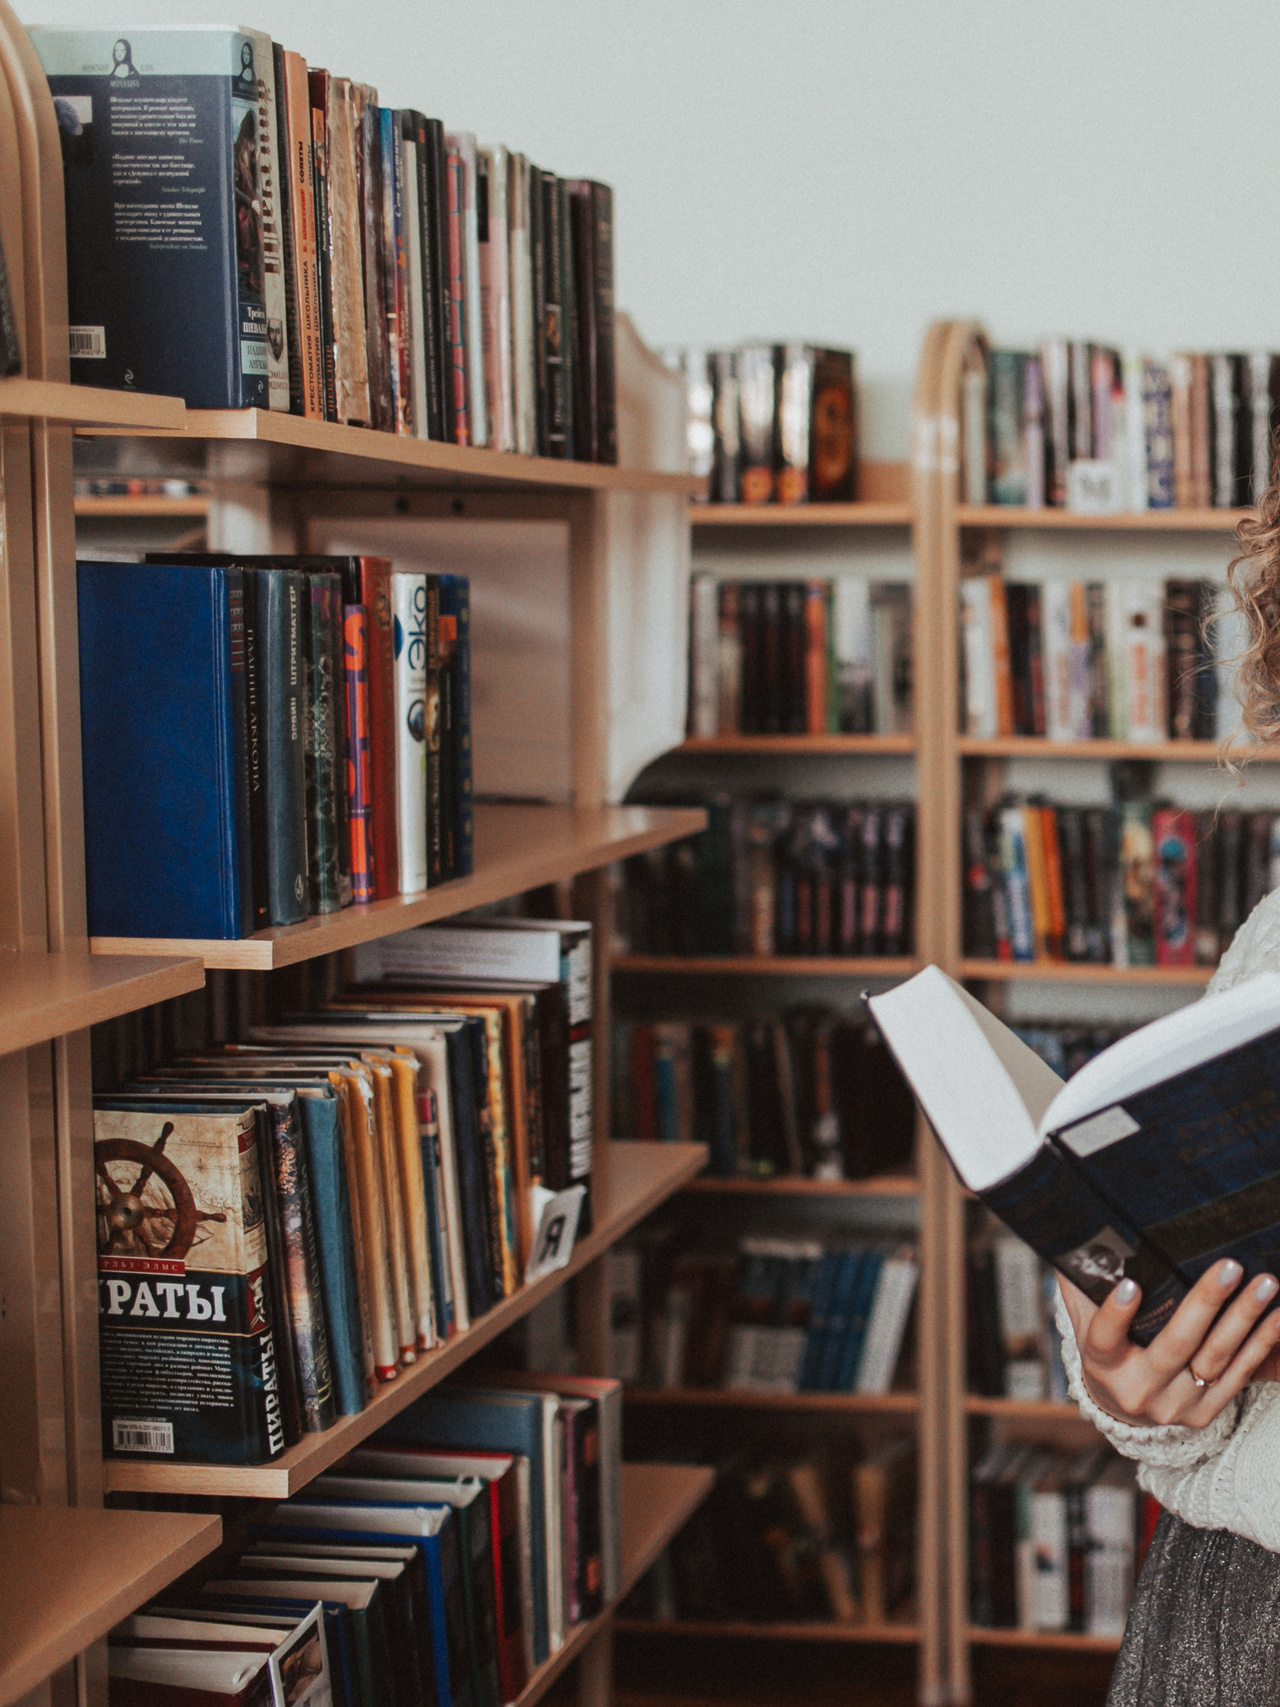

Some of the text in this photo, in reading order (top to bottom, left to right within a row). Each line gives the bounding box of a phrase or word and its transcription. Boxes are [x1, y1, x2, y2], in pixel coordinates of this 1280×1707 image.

[297, 141, 305, 183] СОНЕТЫ
[302, 260, 311, 330] ШКОЛЬНИКА
[307, 335, 315, 412] ХРЕСТОМАТИЯ
[290, 697, 298, 740] ЭРВИН
[538, 1214, 566, 1264] Я
[143, 1262, 179, 1273] ЭЛМС
[259, 1330, 285, 1456] ПИРАТЫ
